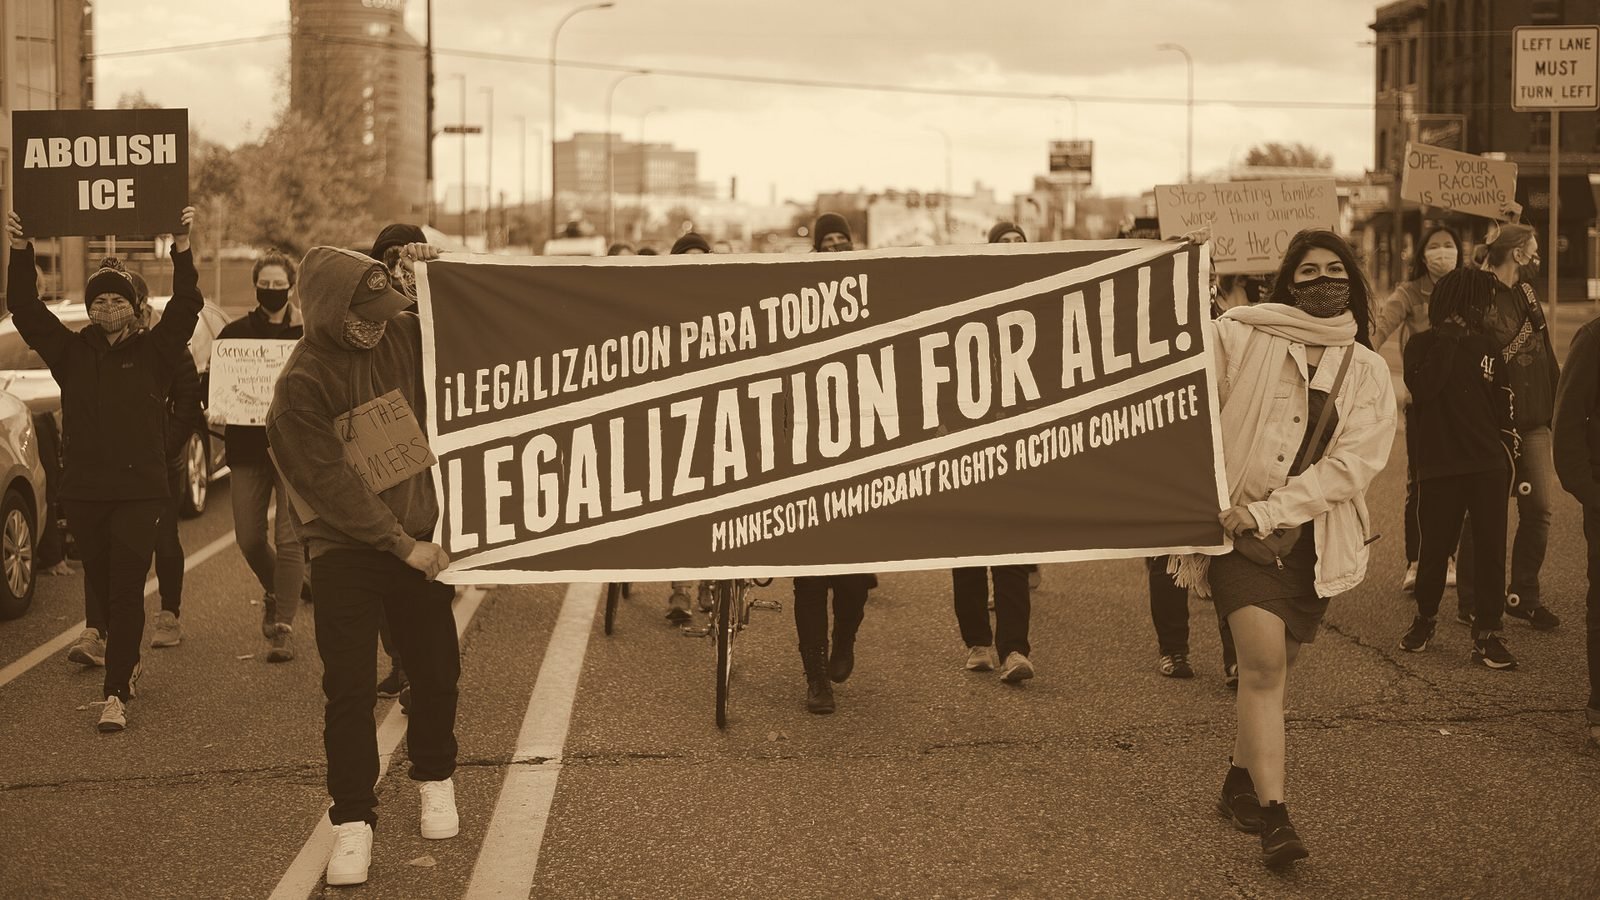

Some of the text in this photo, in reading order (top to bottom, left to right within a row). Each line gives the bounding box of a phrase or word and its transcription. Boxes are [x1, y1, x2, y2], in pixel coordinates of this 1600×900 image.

[1522, 37, 1592, 51] LEFT LANE
[1535, 60, 1578, 76] MUST
[1520, 85, 1592, 99] TURN LEFT
[24, 133, 177, 169] ABOLISH
[1455, 160, 1490, 175] YOUR
[78, 178, 135, 211] ICE
[1438, 173, 1498, 191] RACISM
[1168, 182, 1324, 208] Stop treating families
[1420, 190, 1506, 209] IS SHOWING
[1181, 202, 1320, 227] worse than animals.
[1245, 231, 1272, 256] the
[444, 273, 870, 421] ¡LEGALIZACION PARA TODXS!
[361, 397, 409, 430] THE
[448, 251, 1192, 554] LEGALIZATION FOR ALL!
[711, 384, 1199, 553] MINNESOTA IMMIGRANT RIGHTS ACTION COMMITTEE
